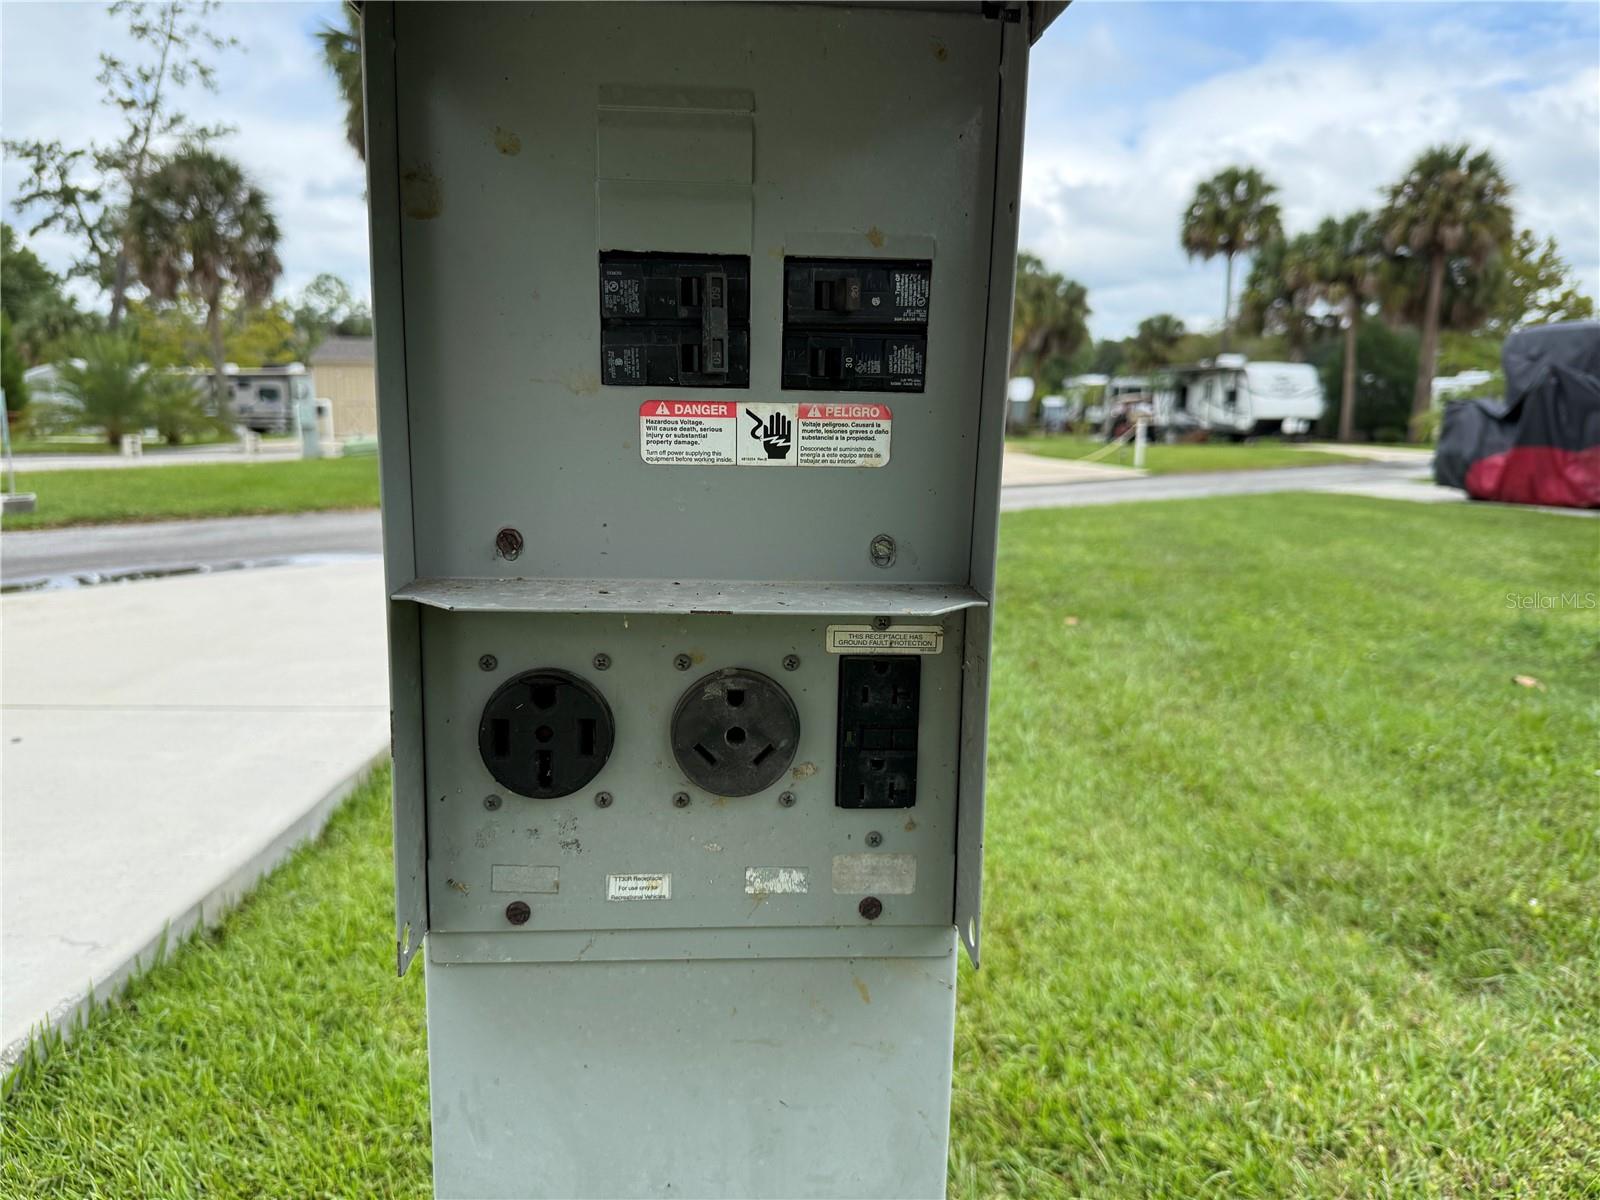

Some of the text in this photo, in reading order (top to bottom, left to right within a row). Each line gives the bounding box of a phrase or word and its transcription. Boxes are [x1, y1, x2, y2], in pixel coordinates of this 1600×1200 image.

[845, 357, 854, 368] 30
[674, 404, 728, 416] DANGER
[825, 406, 880, 418] PELIGRO
[686, 450, 711, 458] supplying
[694, 456, 715, 464] working
